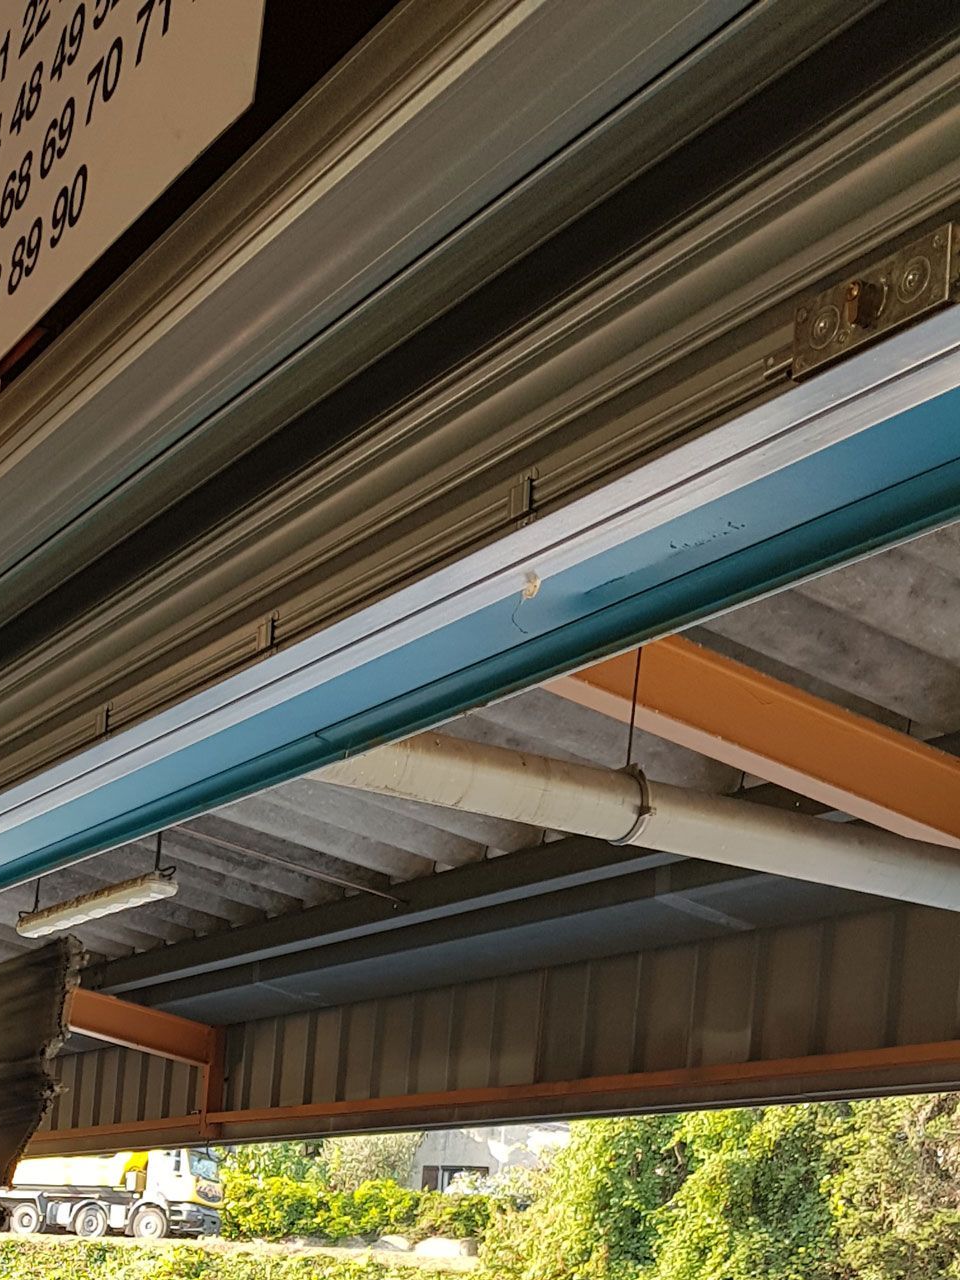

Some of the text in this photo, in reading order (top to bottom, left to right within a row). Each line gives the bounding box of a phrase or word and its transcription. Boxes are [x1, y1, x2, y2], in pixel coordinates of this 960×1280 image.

[0, 150, 33, 228] 68
[40, 96, 76, 180] 69
[85, 36, 124, 126] 70
[9, 61, 44, 136] 48
[50, 2, 86, 82] 49
[7, 216, 42, 296] 89
[50, 164, 88, 249] 90
